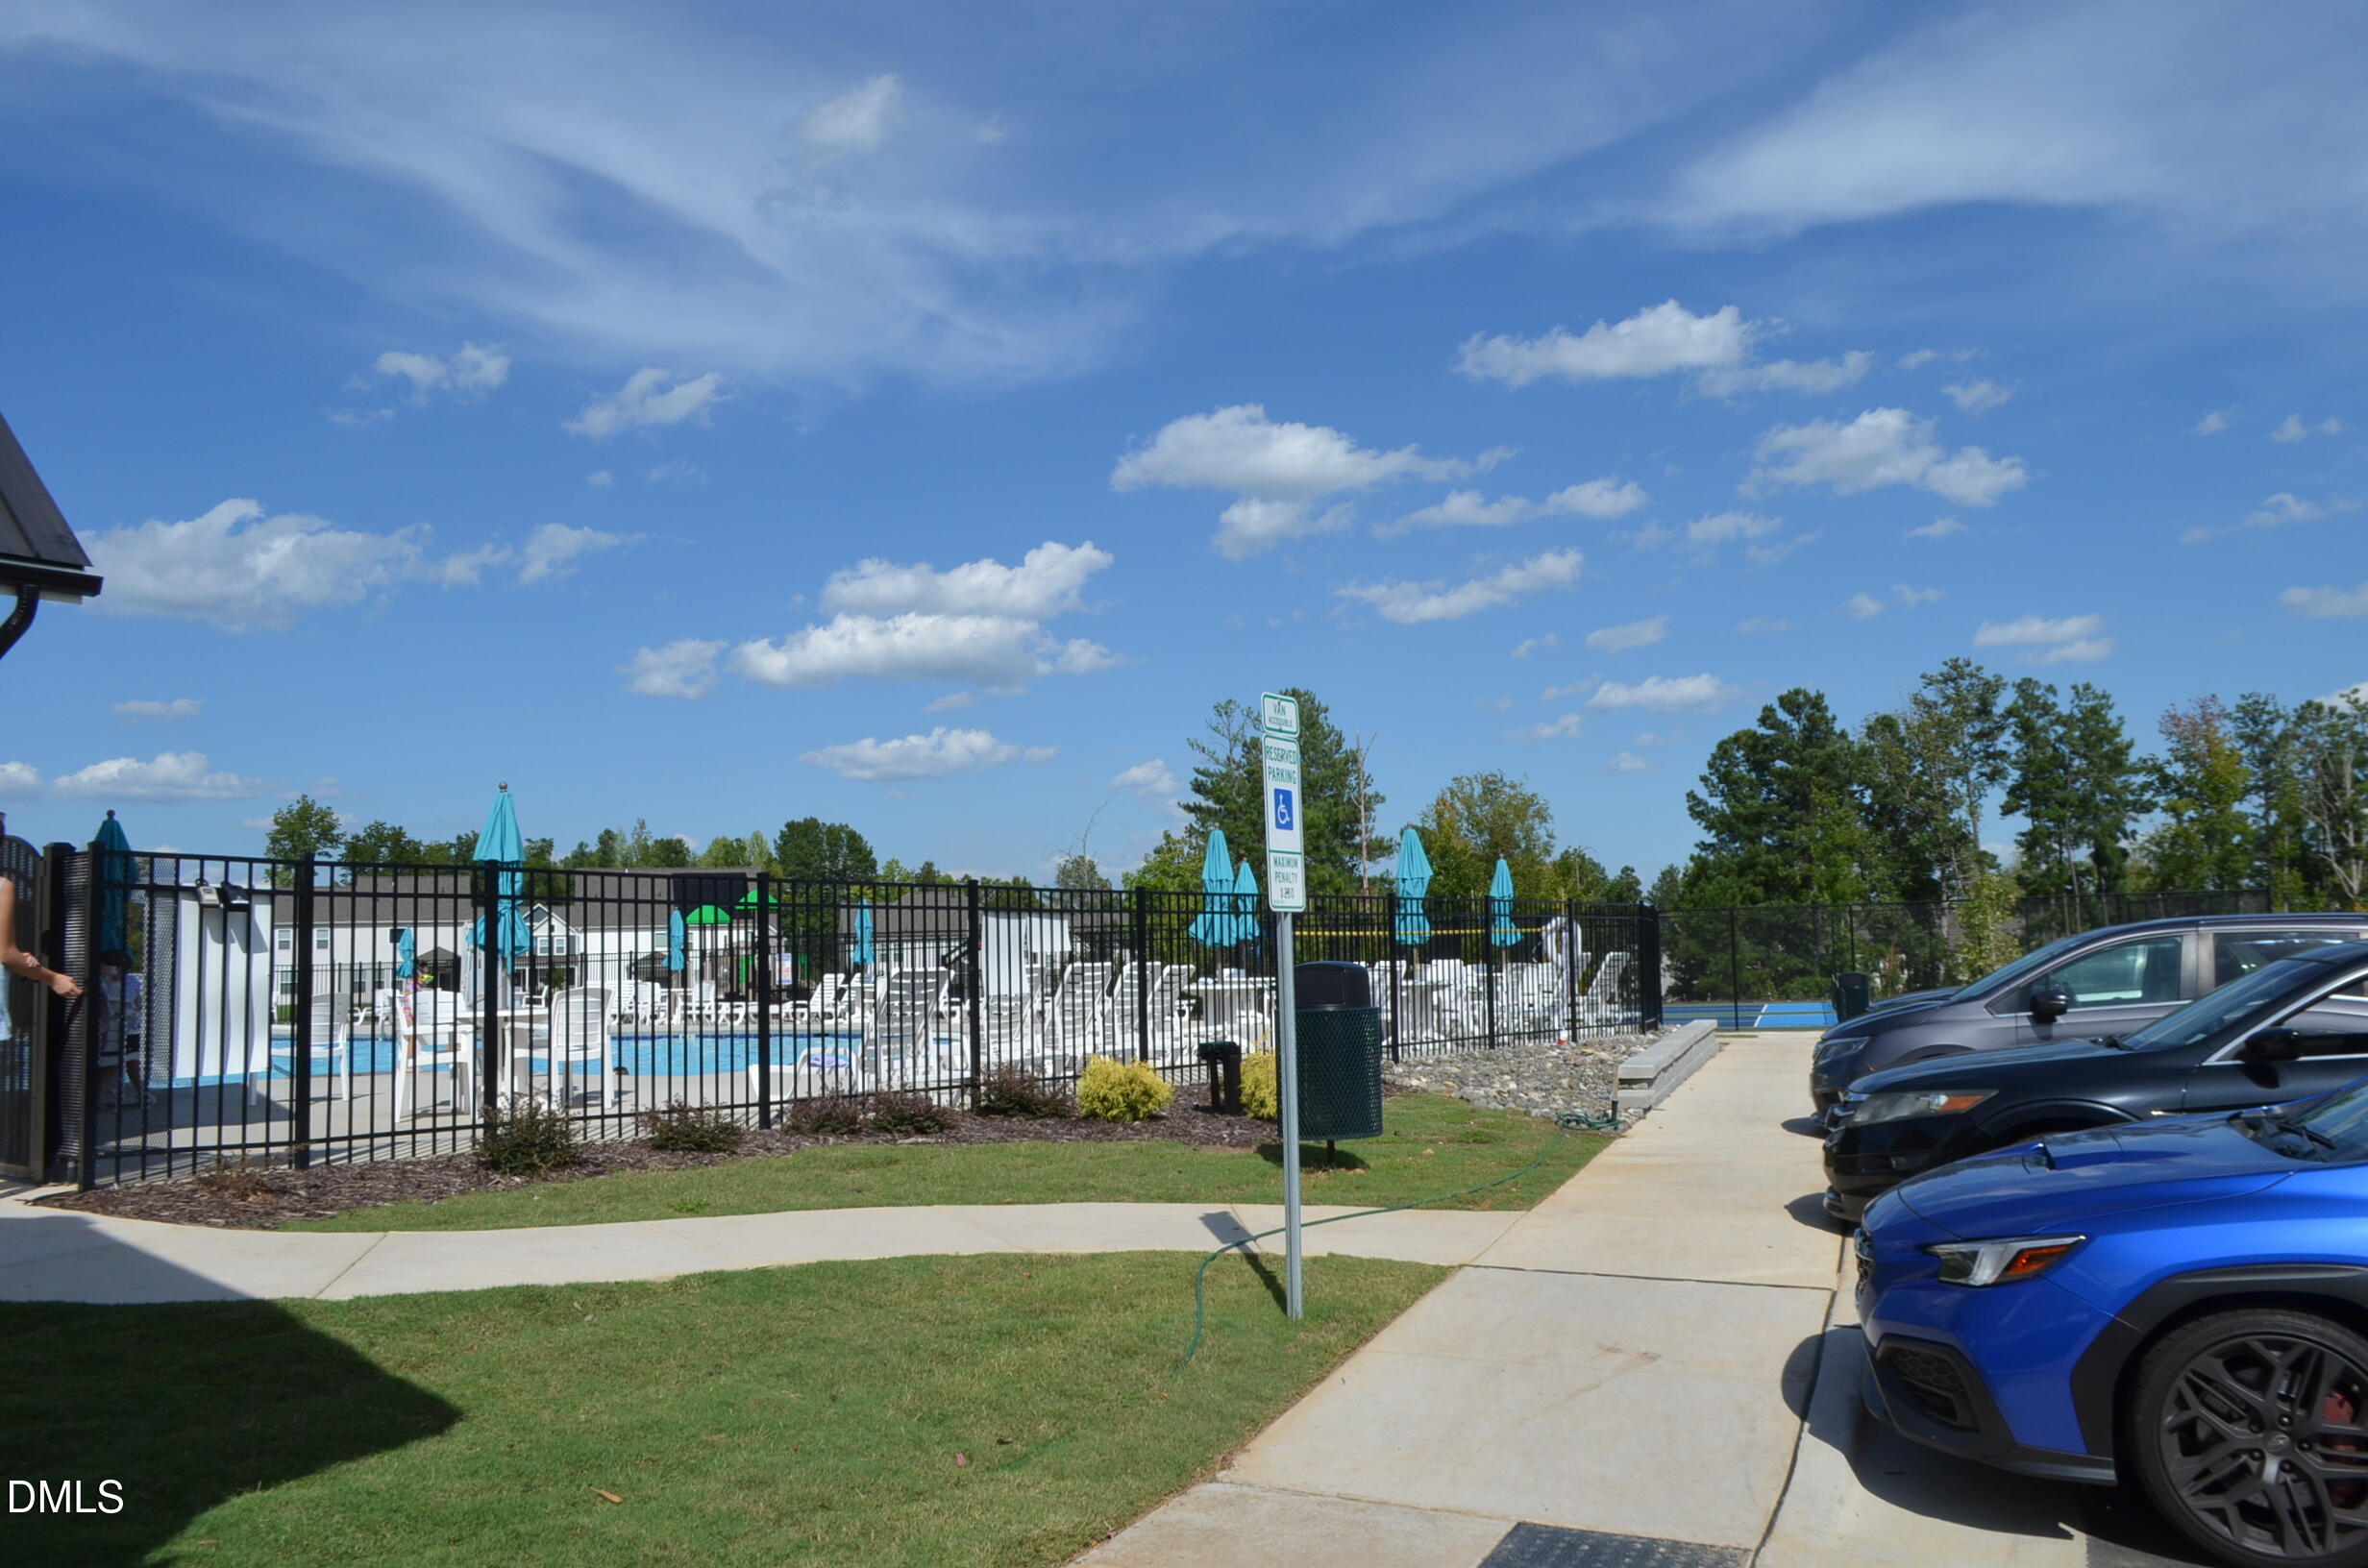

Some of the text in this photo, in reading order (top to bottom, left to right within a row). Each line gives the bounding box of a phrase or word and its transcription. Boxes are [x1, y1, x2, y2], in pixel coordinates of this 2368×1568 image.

[1265, 746, 1297, 765] RESERVED
[1269, 766, 1296, 785] PARKING
[1273, 856, 1298, 869] MAXIMUM
[1274, 871, 1297, 884] PENALTY
